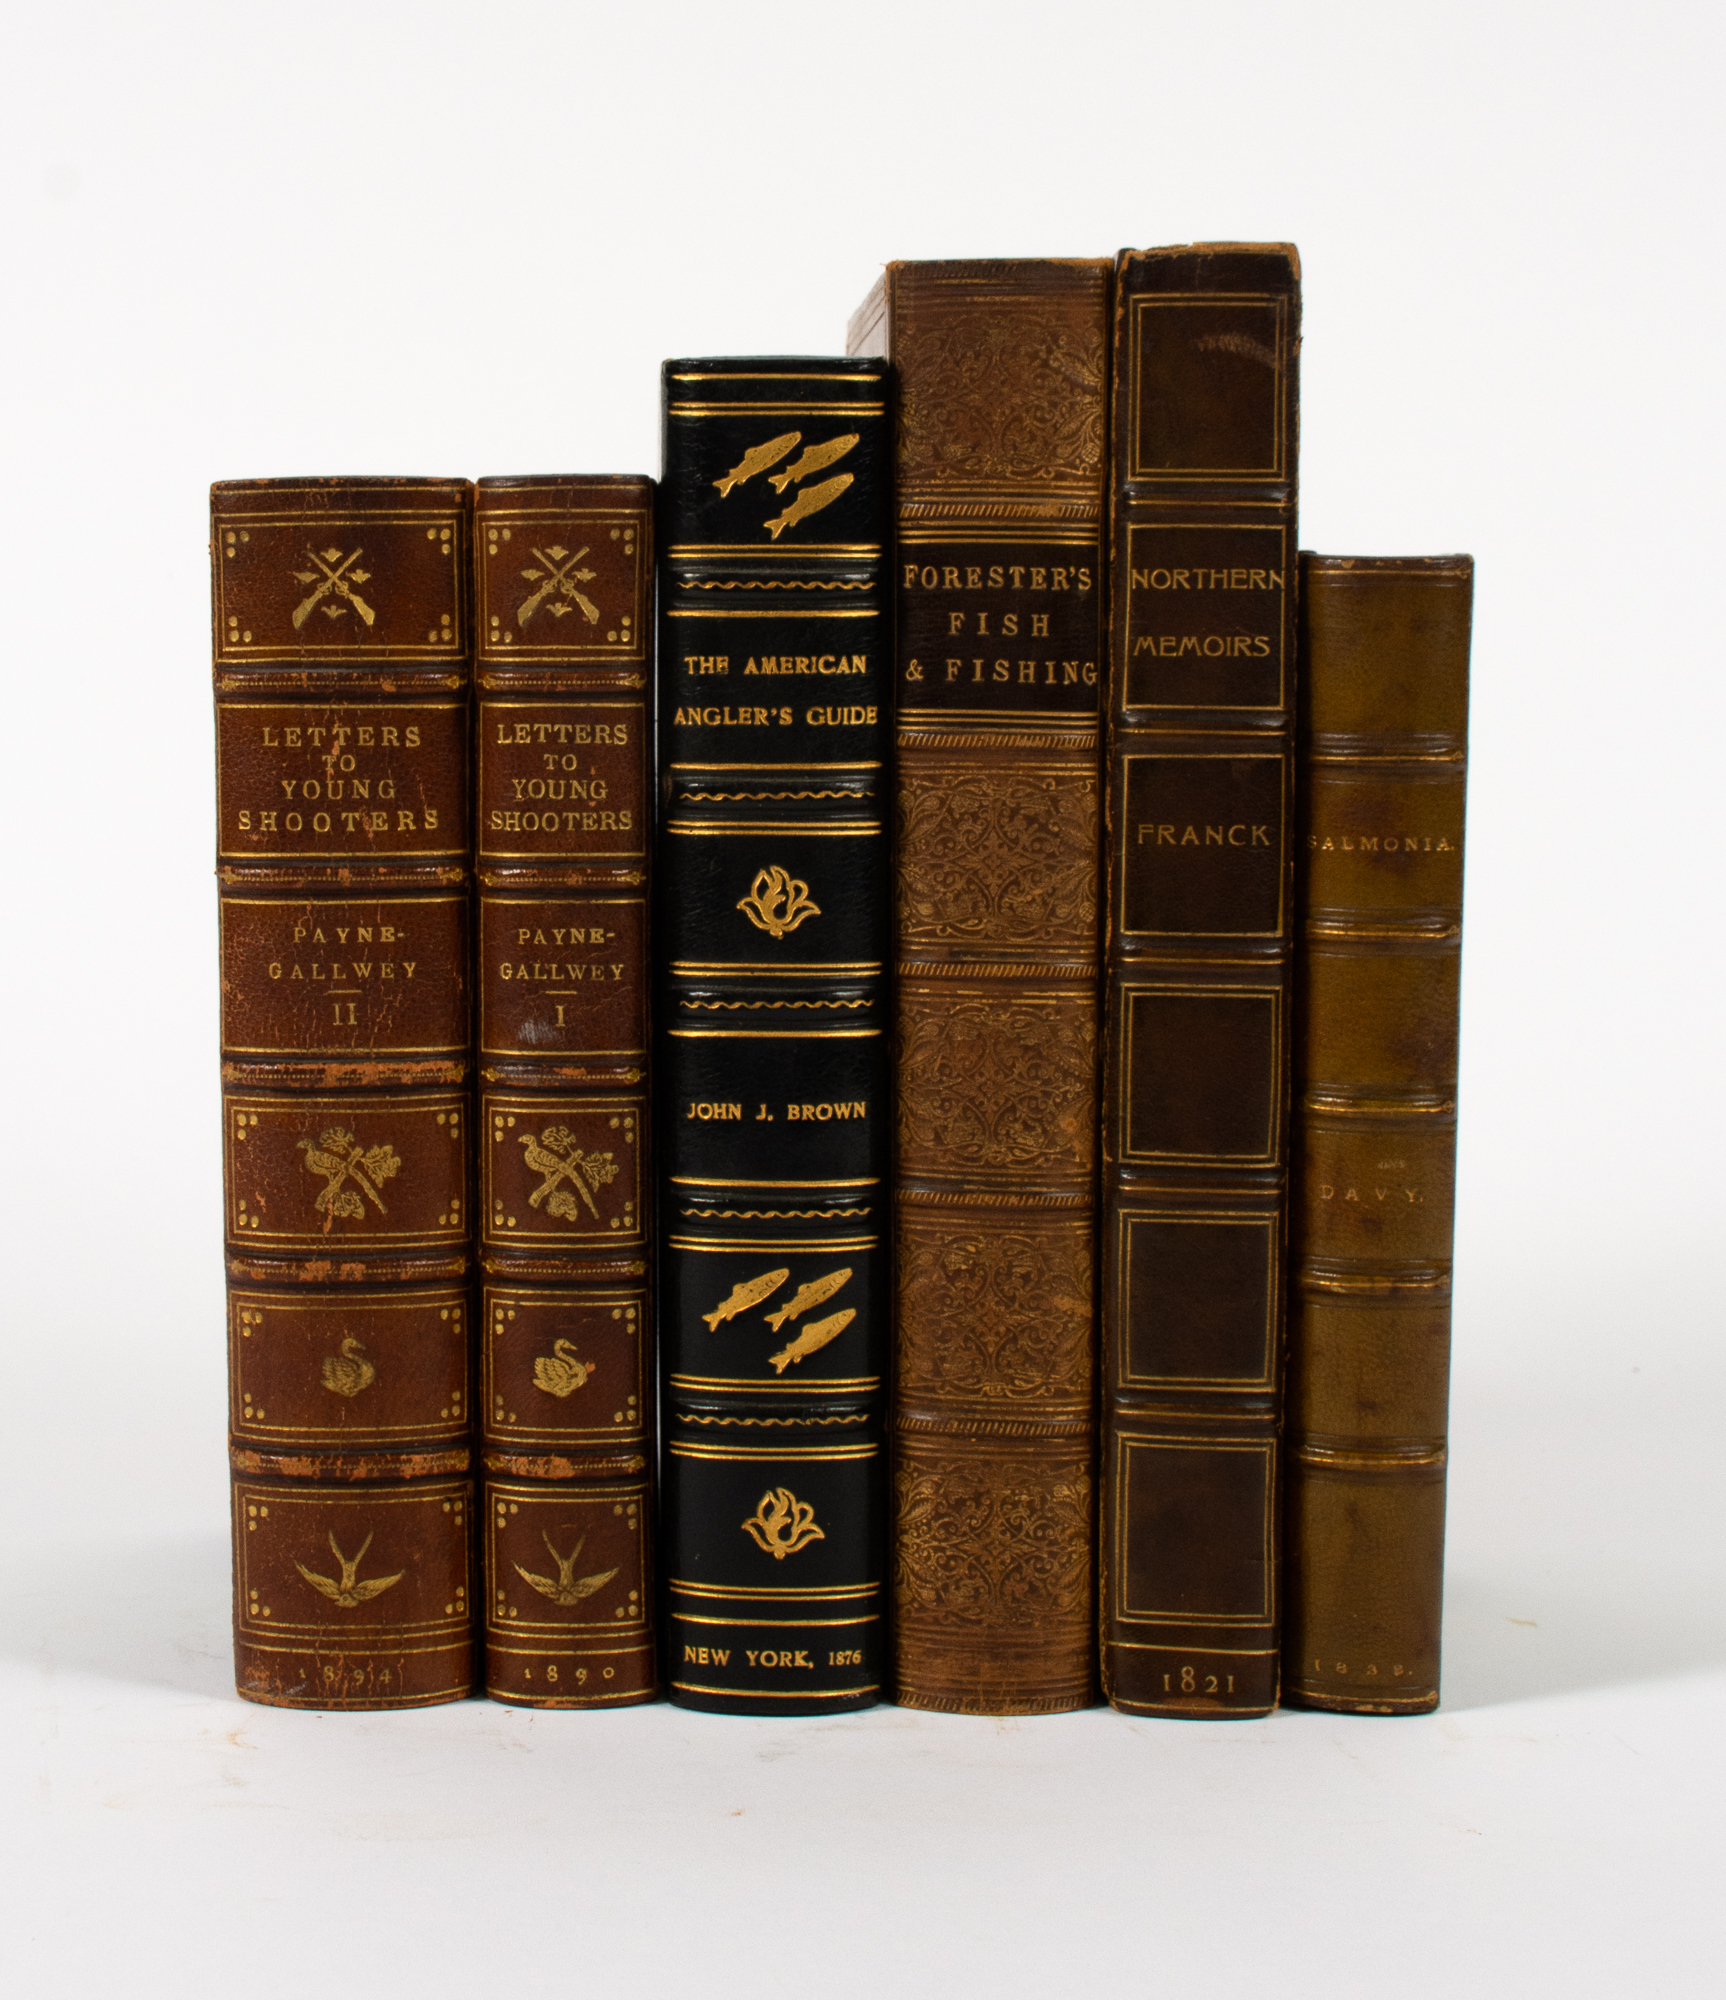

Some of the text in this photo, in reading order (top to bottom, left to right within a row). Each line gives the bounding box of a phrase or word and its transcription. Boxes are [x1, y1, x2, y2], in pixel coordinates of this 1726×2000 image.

[903, 565, 1092, 590] FORESTER'S
[1131, 569, 1285, 590] NORTHERN
[948, 612, 1050, 638] FISH
[1133, 636, 1270, 657] MEMOIRS
[684, 655, 868, 675] THE AMERICAN
[905, 659, 1098, 686] & FISHING
[673, 706, 878, 726] ANGLER'S GUIDE
[263, 726, 421, 748] LETTERS
[497, 723, 629, 746] LETTERS
[322, 754, 356, 772] TO
[543, 754, 578, 771] TO
[281, 779, 396, 800] YOUNG
[511, 778, 609, 800] YOUNG
[238, 810, 440, 832] SHOOTERS
[490, 810, 633, 832] SHOOTERS
[1137, 825, 1271, 846] FRANCK
[293, 926, 405, 943] PAYNE-
[518, 928, 616, 945] PAYNE-
[268, 962, 417, 979] GALLWEY
[500, 963, 625, 981] GALLWEY
[332, 1003, 358, 1026] II
[555, 1005, 566, 1027] I
[687, 1102, 867, 1121] JOHN J. BROWN
[1320, 1185, 1424, 1203] DAVY.
[684, 1646, 862, 1669] NEW YORK, 1876
[298, 1667, 393, 1685] 1894
[524, 1666, 616, 1685] 1890
[1163, 1666, 1235, 1693] 1821
